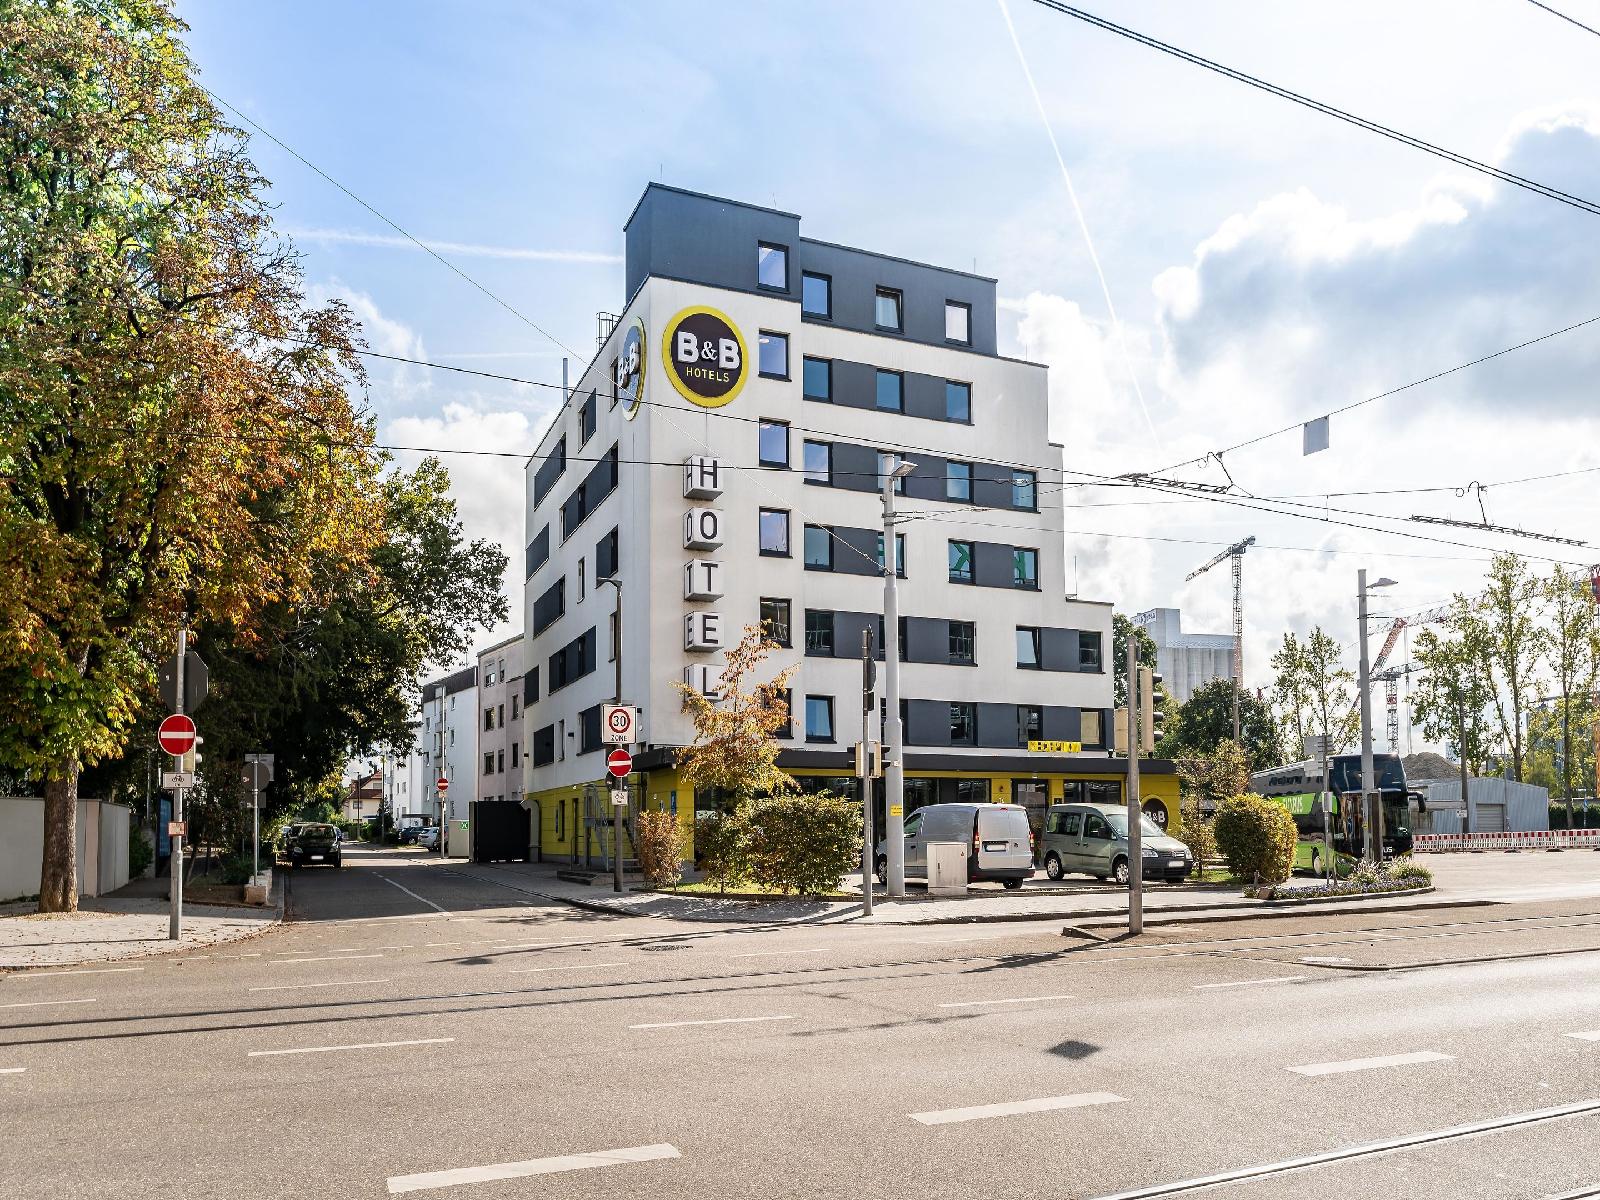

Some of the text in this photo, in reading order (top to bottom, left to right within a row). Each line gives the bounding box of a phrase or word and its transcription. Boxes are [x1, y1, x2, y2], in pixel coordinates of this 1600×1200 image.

[678, 331, 740, 369] B&B
[686, 367, 730, 382] HOTELS
[700, 458, 718, 696] HOTEL
[613, 716, 626, 727] 30
